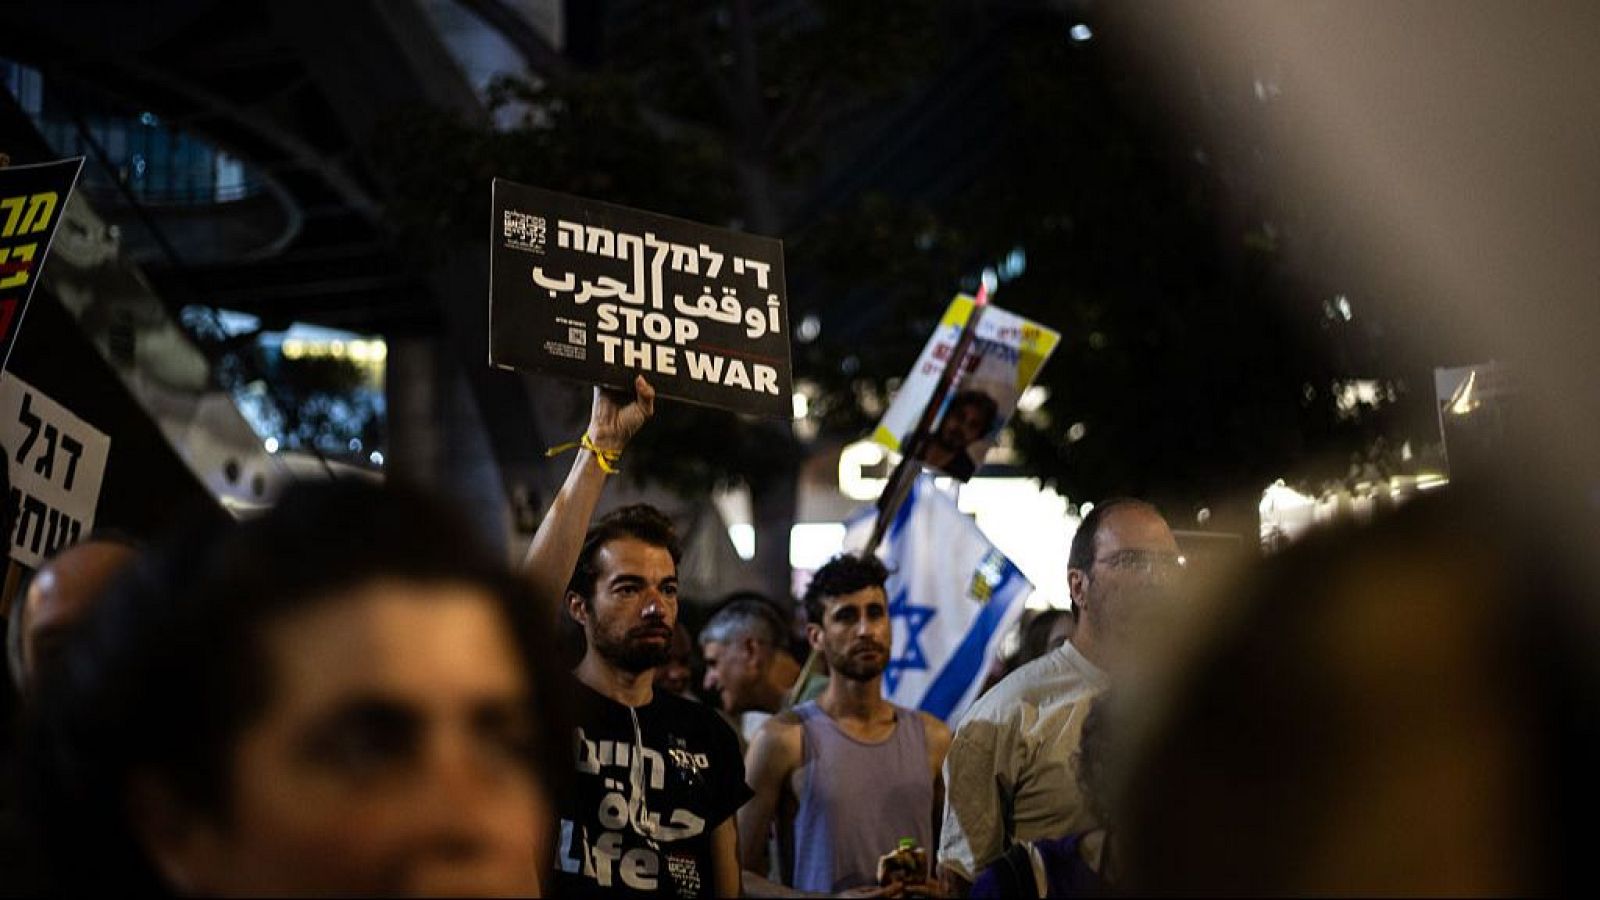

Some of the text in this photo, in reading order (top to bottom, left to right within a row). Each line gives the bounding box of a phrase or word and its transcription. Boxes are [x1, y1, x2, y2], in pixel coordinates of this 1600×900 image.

[532, 265, 665, 309] الحرب
[557, 219, 771, 309] די למלחמה
[597, 303, 699, 345] STOP
[597, 333, 677, 376] THE
[685, 350, 780, 395] WAR
[15, 391, 84, 492] דגל
